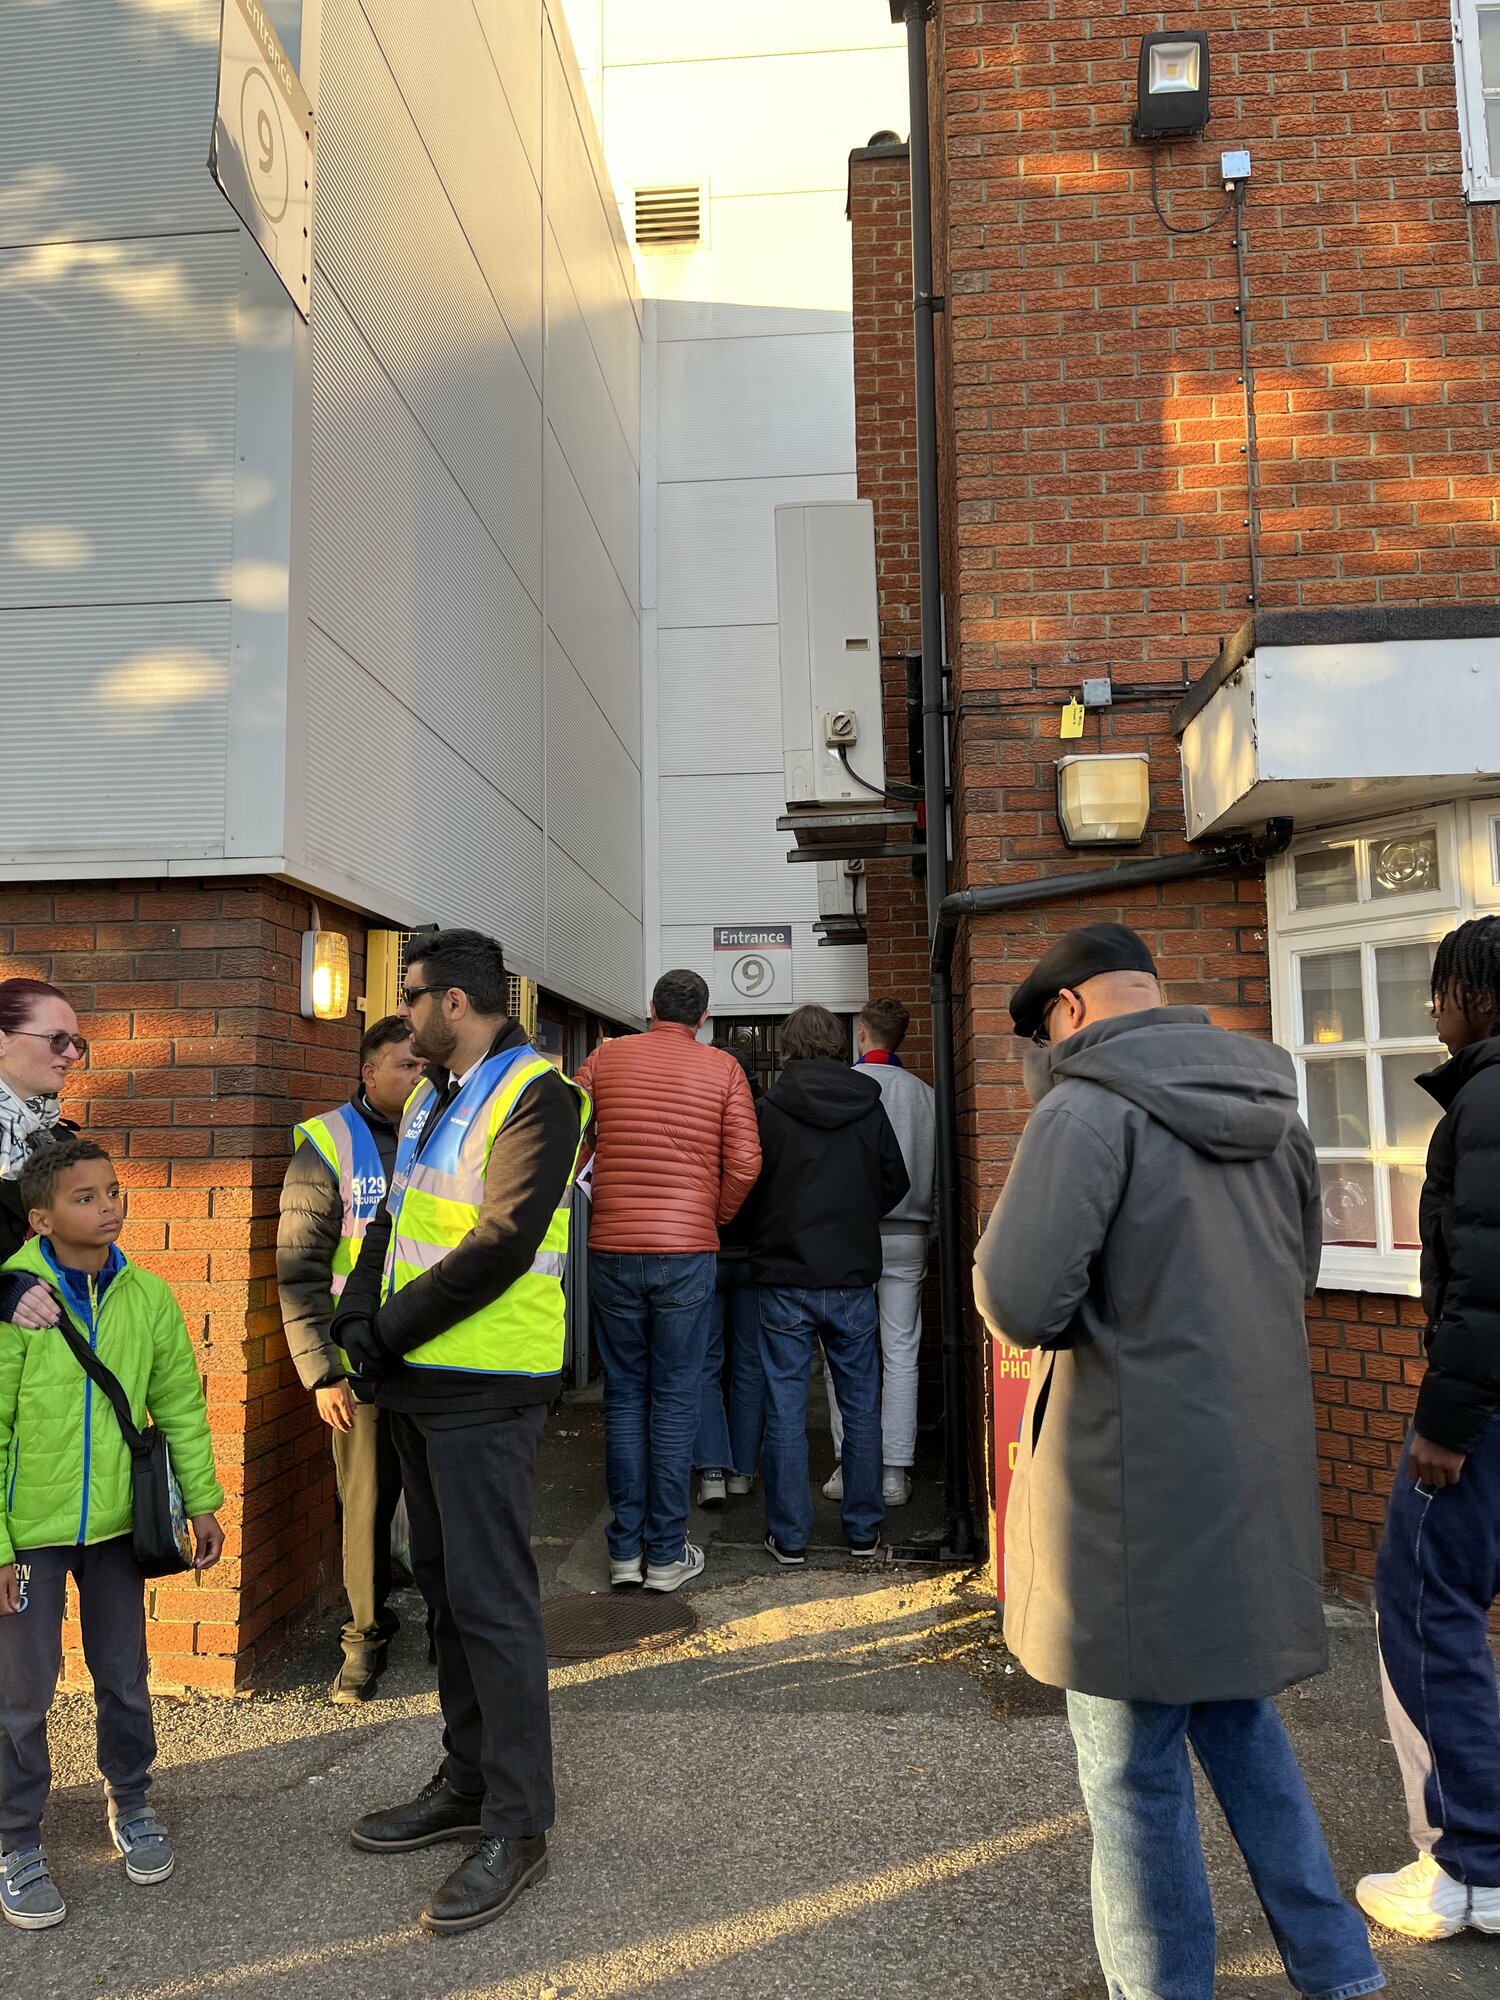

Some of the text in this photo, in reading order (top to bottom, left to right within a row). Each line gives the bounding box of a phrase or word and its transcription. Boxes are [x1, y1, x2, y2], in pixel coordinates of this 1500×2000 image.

[257, 109, 274, 174] 9
[720, 930, 785, 944] Entrance
[742, 960, 765, 992] 9
[352, 1176, 386, 1196] 5129
